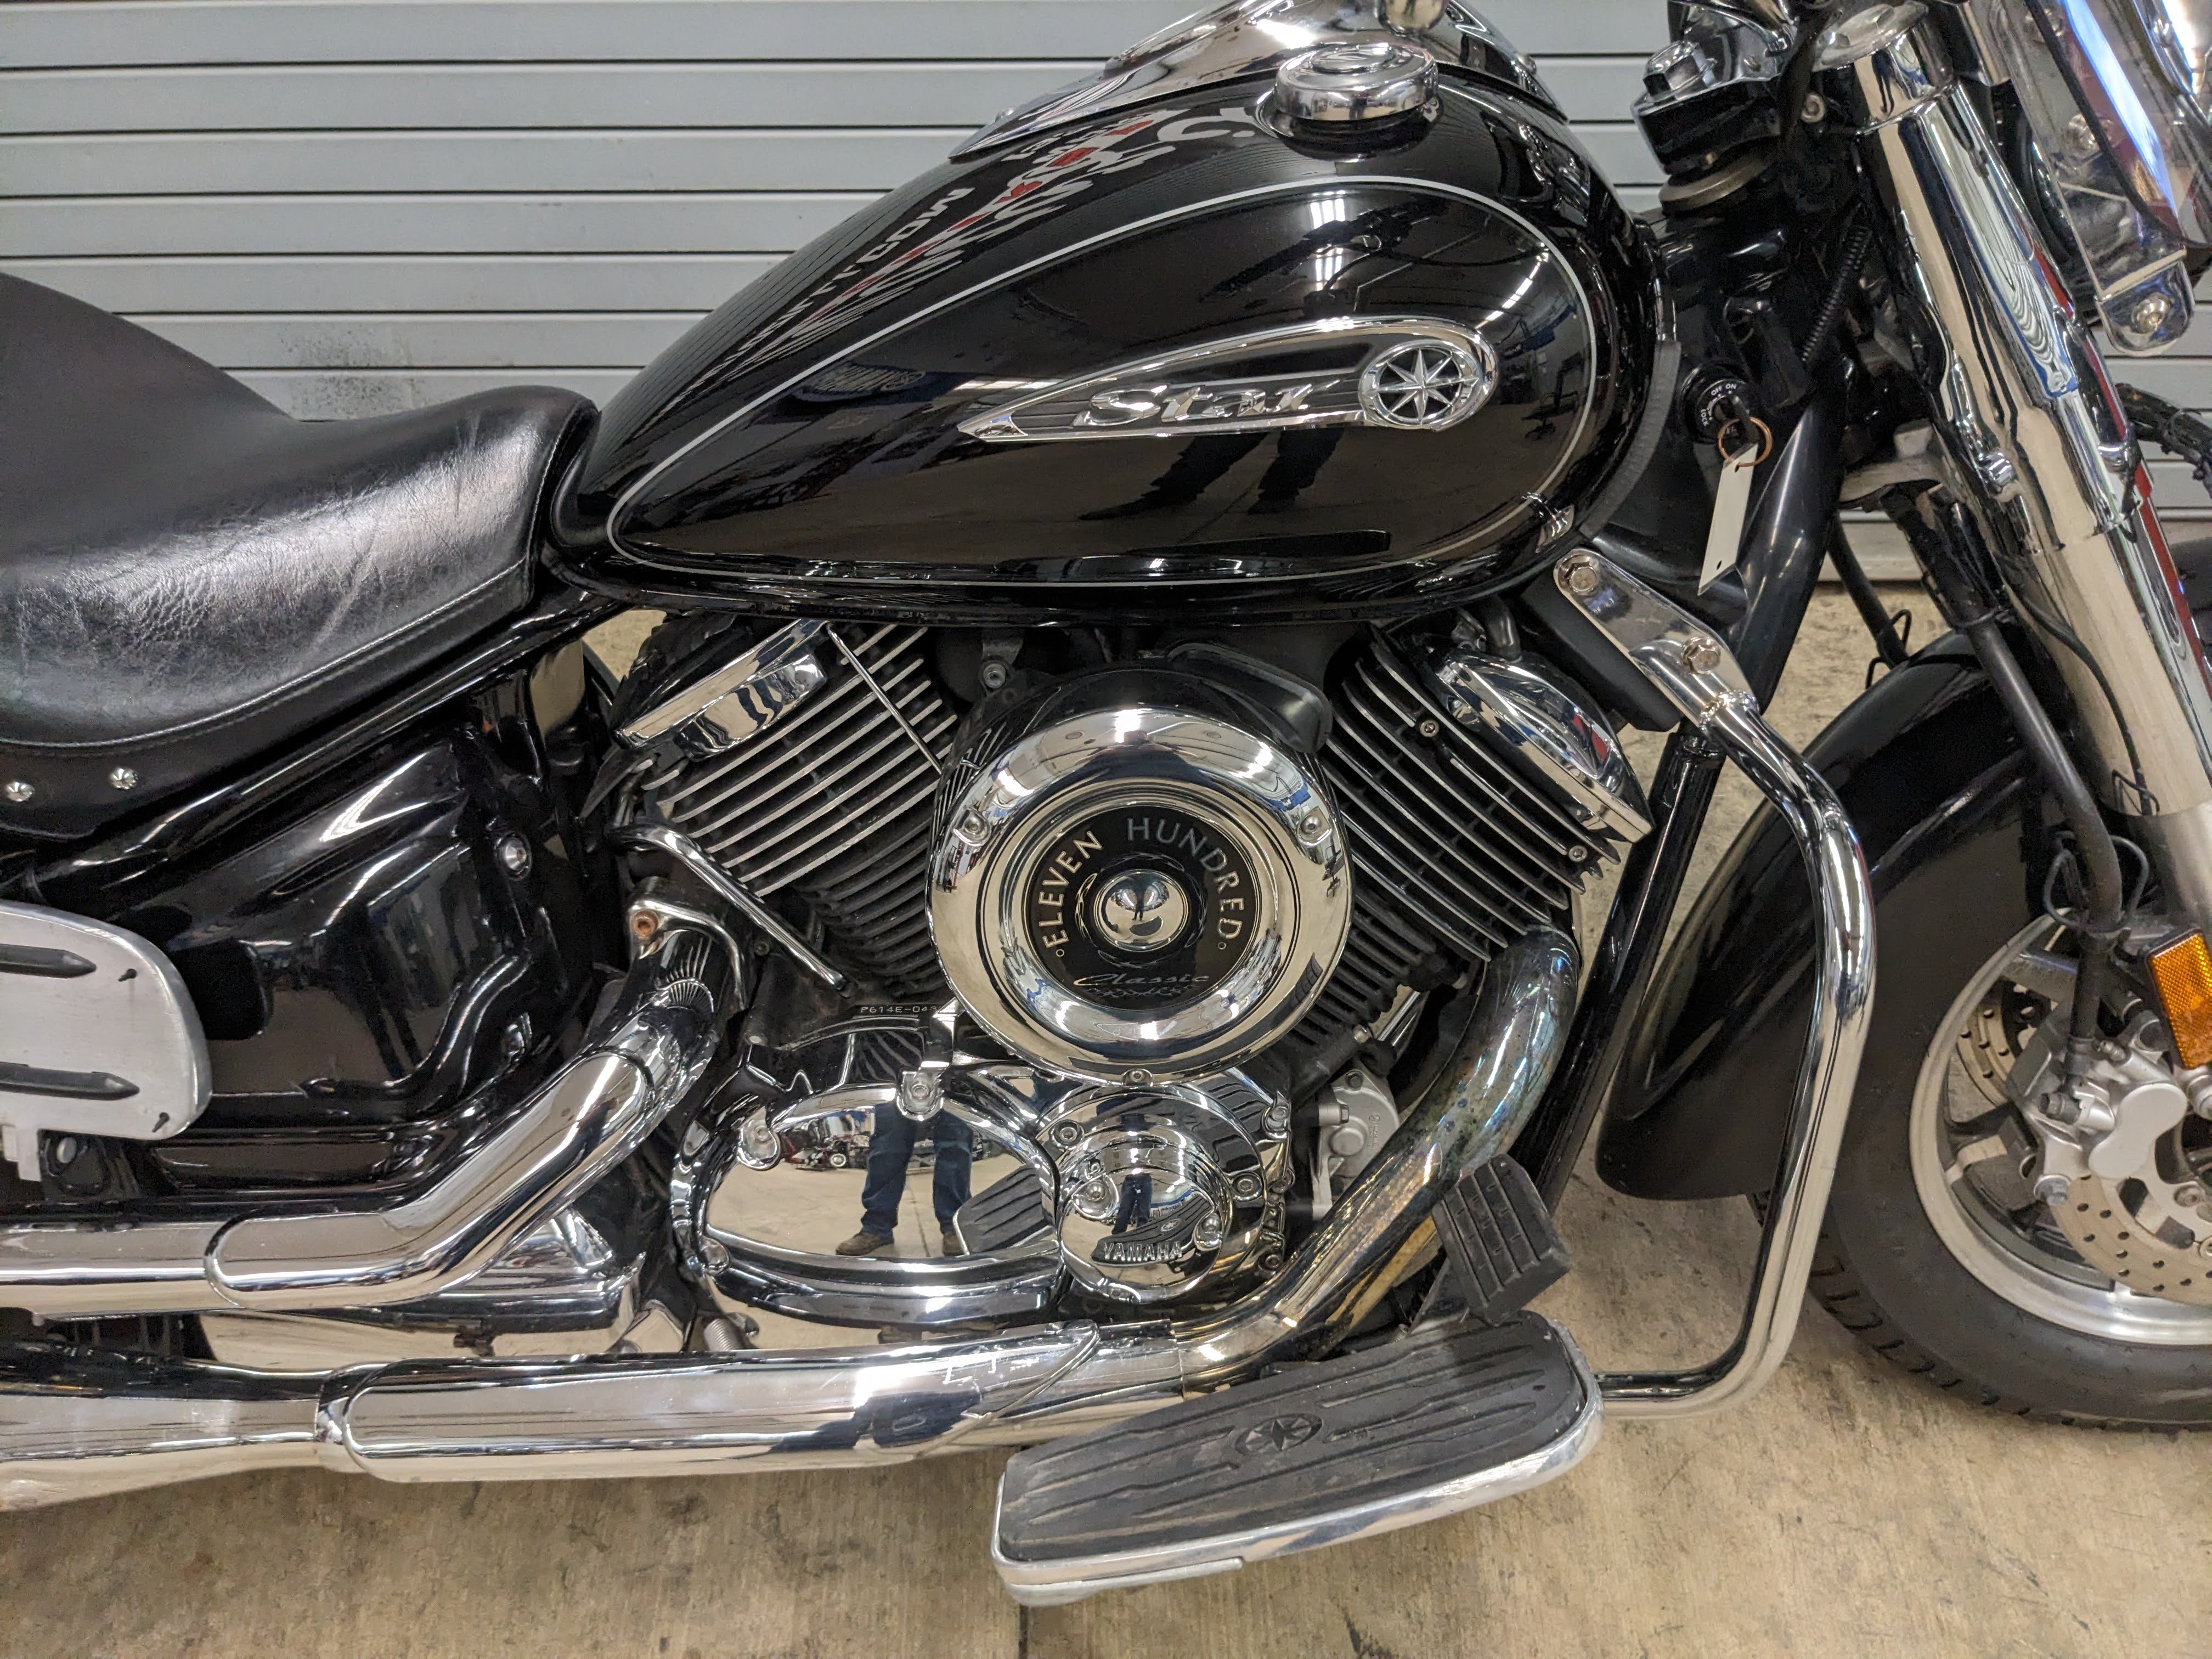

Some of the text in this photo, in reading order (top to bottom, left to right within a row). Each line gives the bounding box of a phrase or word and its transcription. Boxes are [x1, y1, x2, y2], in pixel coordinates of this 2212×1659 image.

[1711, 386, 1723, 396] OFF
[1073, 379, 1340, 426] Star
[1701, 409, 1709, 426] LOCK
[1038, 816, 1244, 949] ELEVEN HUNDRED
[1073, 973, 1210, 986] Classic
[1103, 1241, 1184, 1262] YAMAHA
